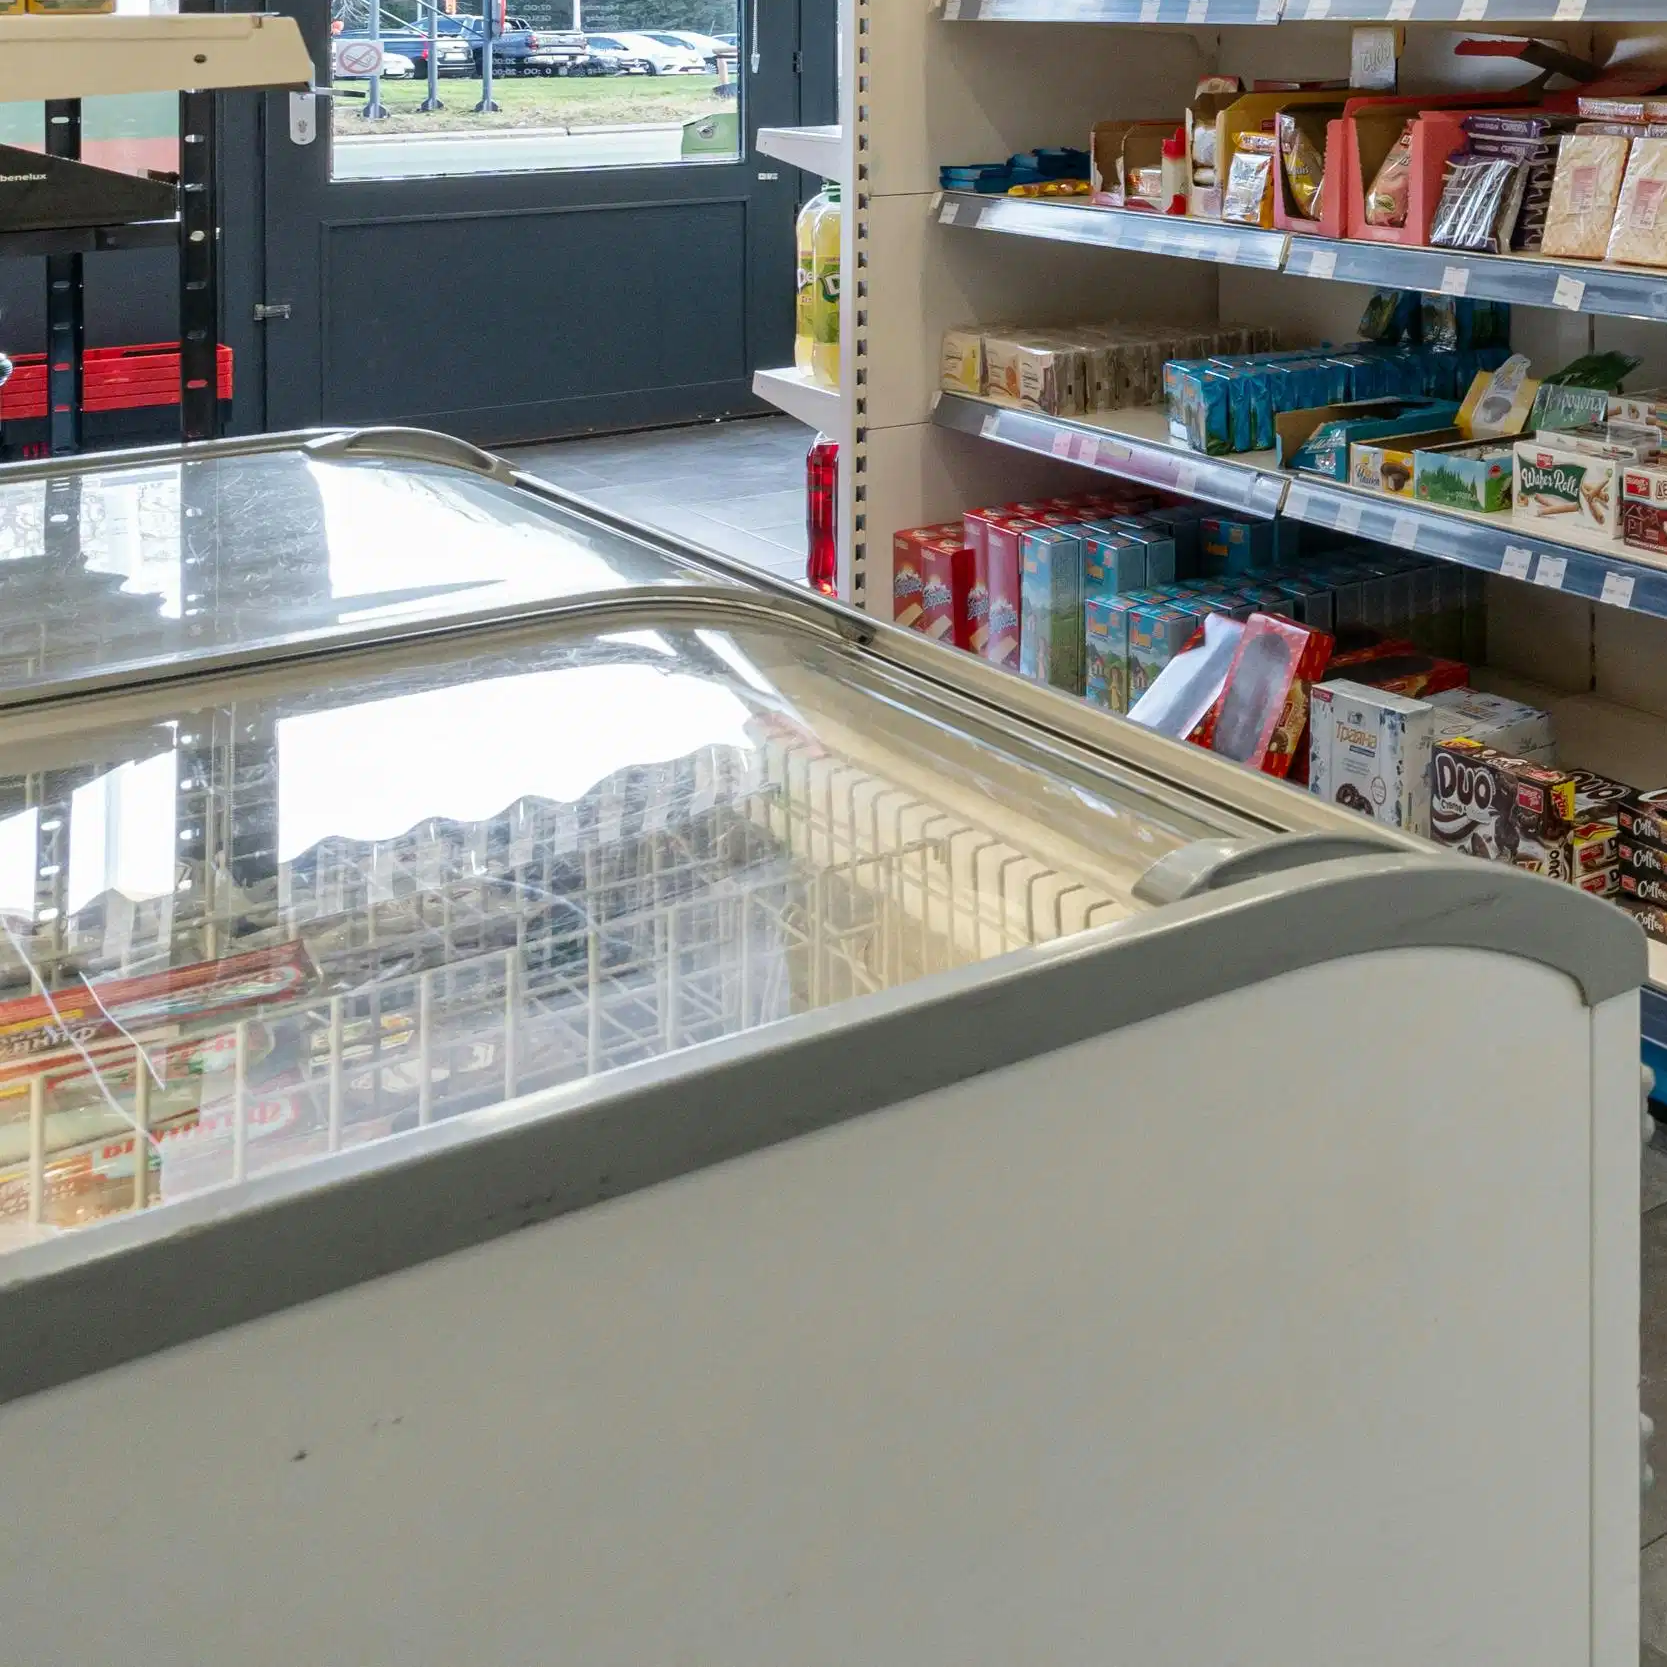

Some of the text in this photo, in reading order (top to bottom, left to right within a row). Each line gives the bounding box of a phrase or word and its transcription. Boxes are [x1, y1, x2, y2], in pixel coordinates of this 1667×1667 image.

[0, 172, 47, 183] benelux
[1521, 466, 1579, 496] Wafer Rolls
[1336, 722, 1377, 750] Траяна
[1632, 818, 1660, 839] Coffee
[1632, 849, 1661, 871] Coffee
[1637, 880, 1667, 900] Coffee
[1634, 912, 1664, 932] Coffee
